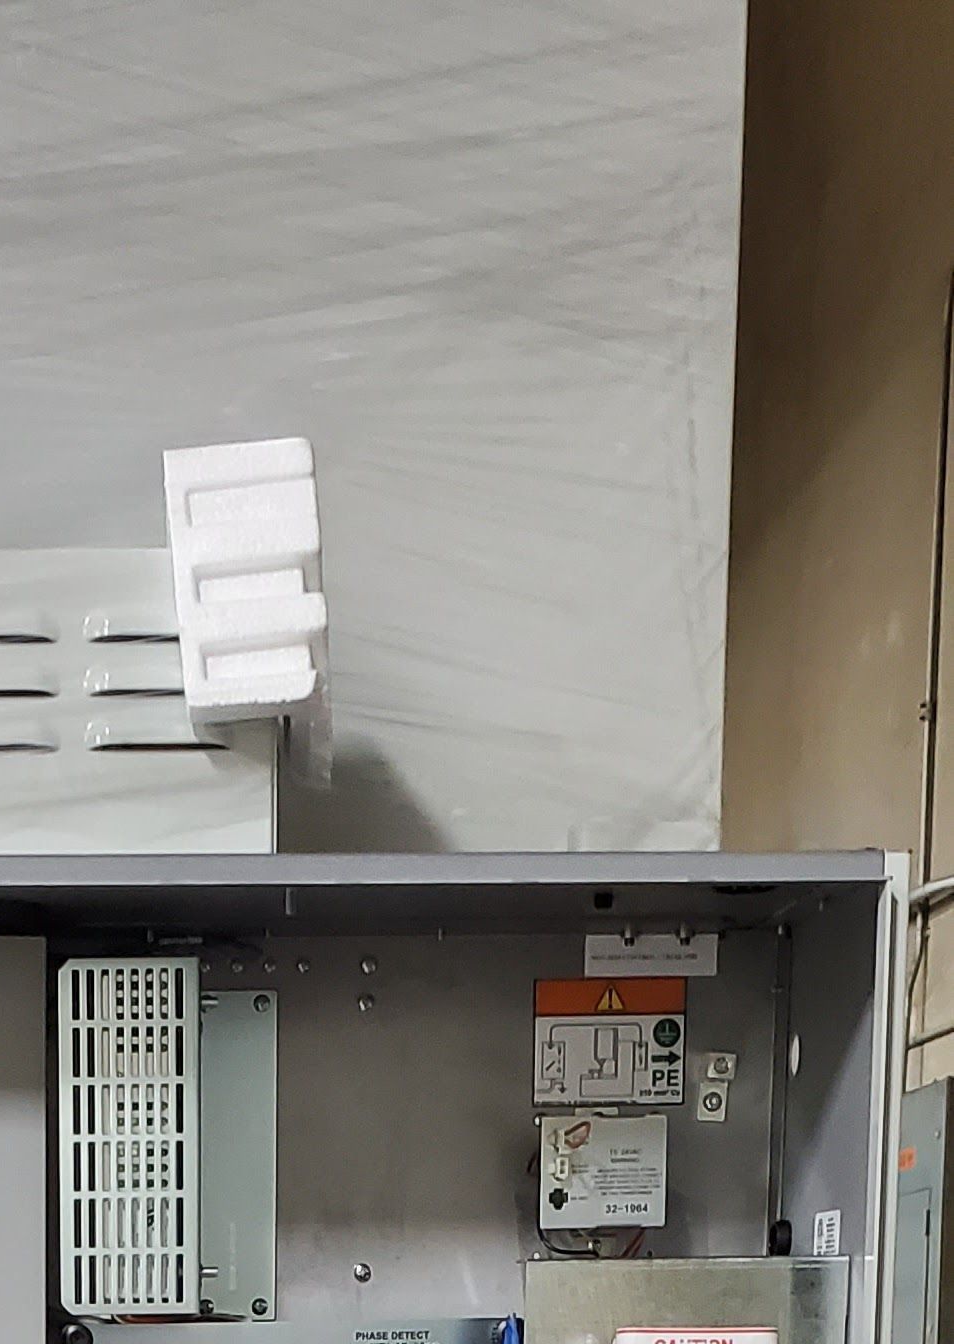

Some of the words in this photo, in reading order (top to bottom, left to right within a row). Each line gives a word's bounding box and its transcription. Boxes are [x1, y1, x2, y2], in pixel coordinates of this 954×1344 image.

[651, 1069, 680, 1087] PE
[605, 1203, 648, 1214] 32-1964
[355, 1331, 389, 1341] PHASE
[390, 1330, 430, 1340] DETECT
